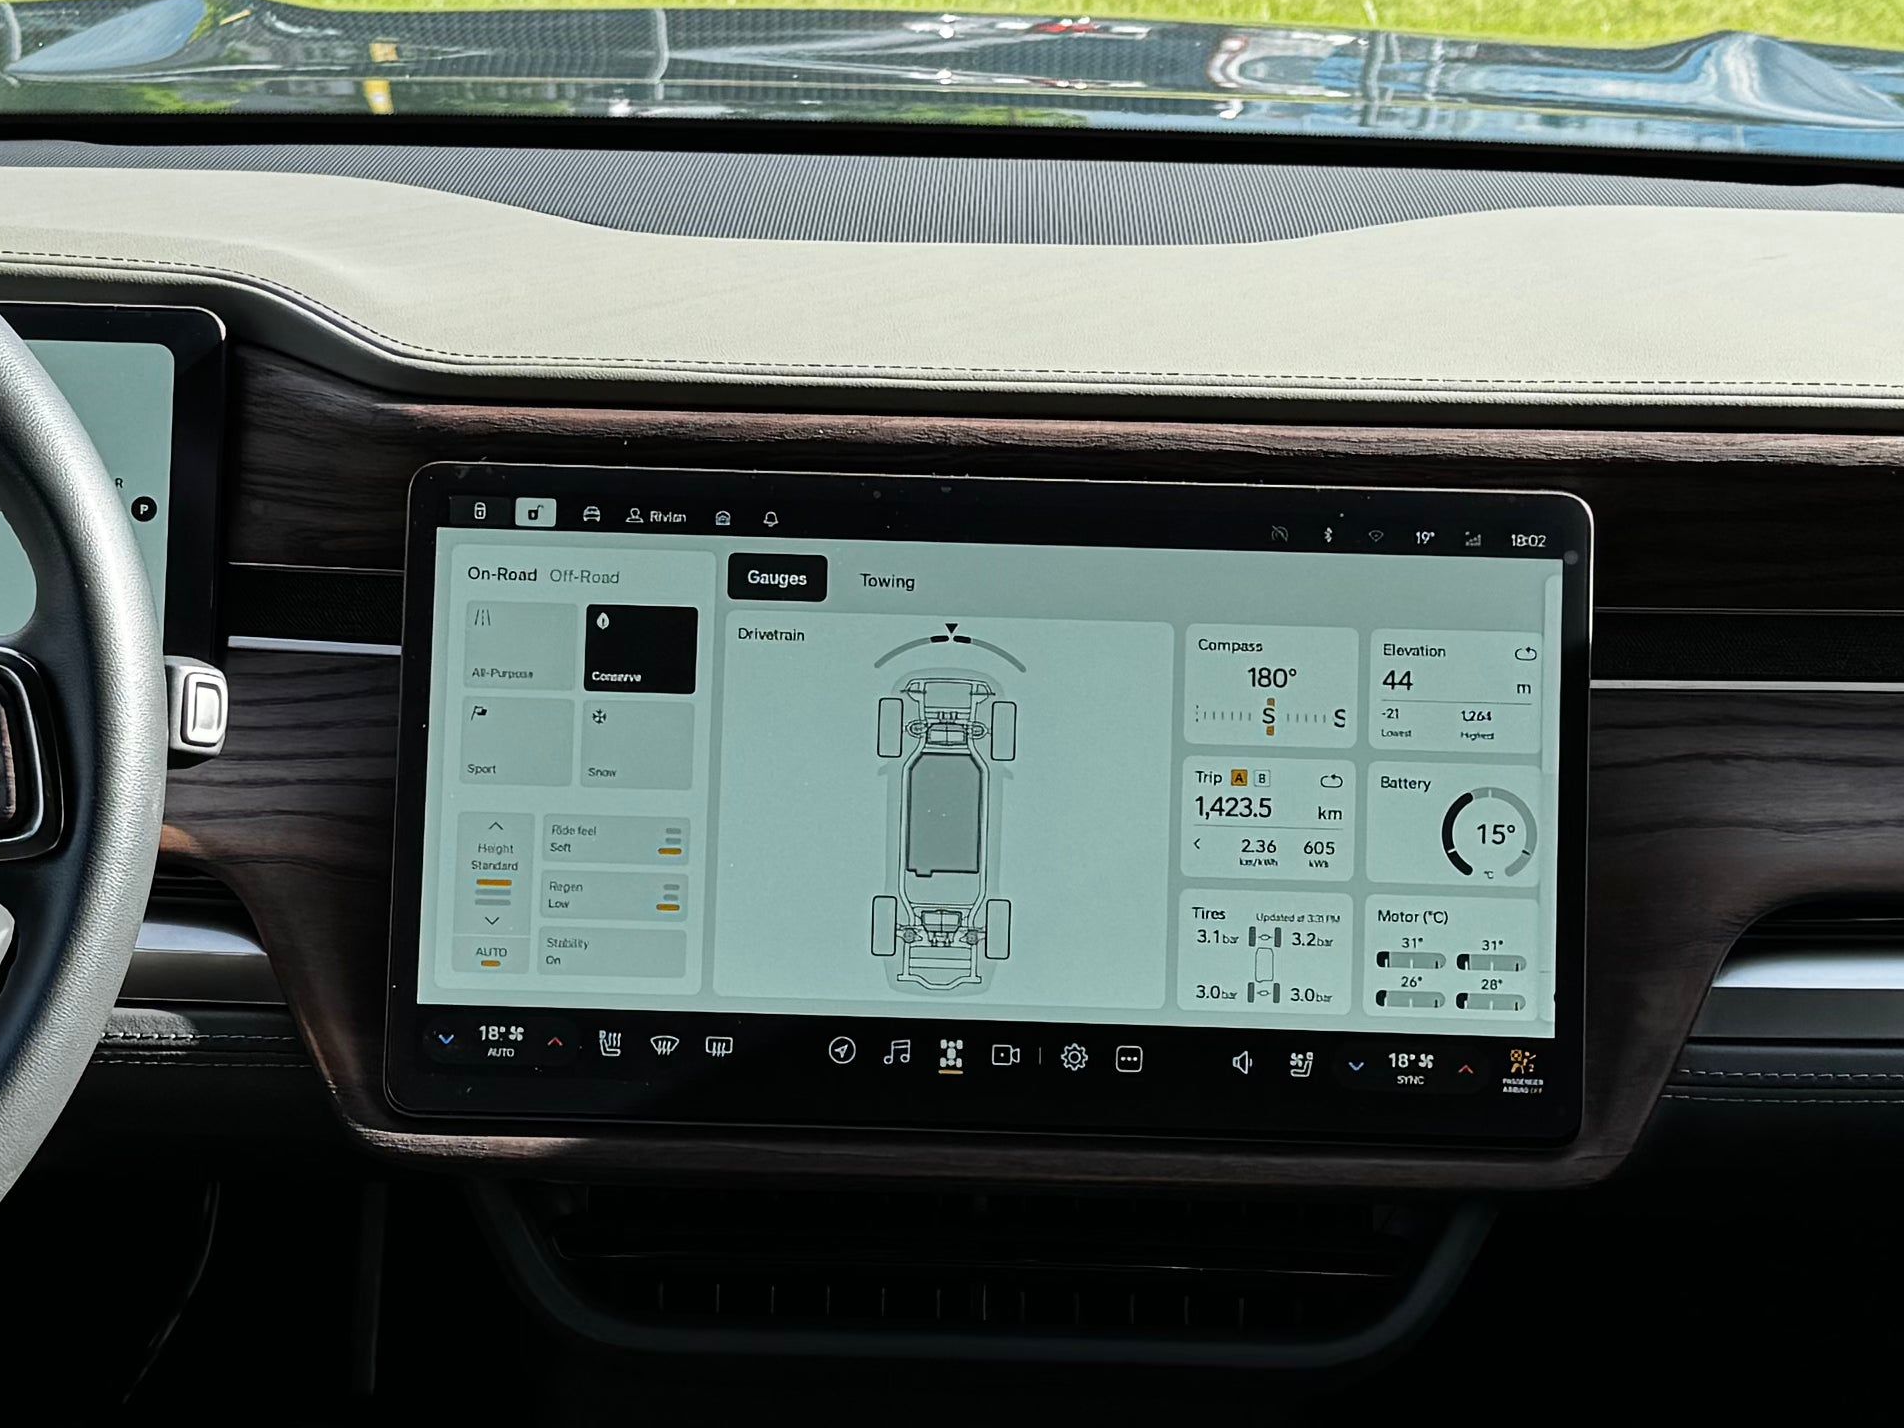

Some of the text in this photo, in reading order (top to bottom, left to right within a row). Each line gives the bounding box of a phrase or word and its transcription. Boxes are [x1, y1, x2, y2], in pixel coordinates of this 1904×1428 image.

[140, 504, 149, 515] P
[1416, 531, 1435, 544] 19°
[468, 567, 537, 581] On-Road
[550, 569, 620, 584] Off-Road
[748, 570, 807, 588] Gauges
[861, 573, 915, 591] Towing
[738, 627, 805, 642] Drivetrain
[1198, 639, 1263, 654] Compass
[1383, 644, 1446, 658] Elevation
[592, 671, 641, 682] Conserve
[1248, 667, 1297, 688] 180°
[1382, 670, 1413, 691] 44
[1516, 683, 1532, 694] m
[1261, 708, 1276, 724] S
[1381, 708, 1399, 719] -21
[467, 763, 496, 775] Sport
[589, 767, 617, 778] Snow
[1196, 771, 1223, 786] Trip
[1380, 776, 1431, 793] Battery
[1195, 796, 1342, 820] 1,423.5 km
[1477, 824, 1516, 845] 15°
[478, 843, 514, 855] Height
[550, 842, 571, 853] Soft
[1241, 839, 1276, 853] 2.36
[1304, 841, 1335, 855] 605
[471, 860, 518, 872] Standard
[548, 898, 570, 910] Low
[1192, 907, 1226, 920] Tires
[1378, 910, 1448, 926] Motor (°C)
[1401, 937, 1423, 949] 31°
[1482, 940, 1503, 951] 31°
[476, 947, 507, 958] AUTO
[546, 955, 561, 965] On
[1401, 976, 1423, 988] 26°
[1481, 979, 1503, 990] 28°
[487, 1047, 514, 1057] AUTO
[1389, 1053, 1415, 1068] 18°
